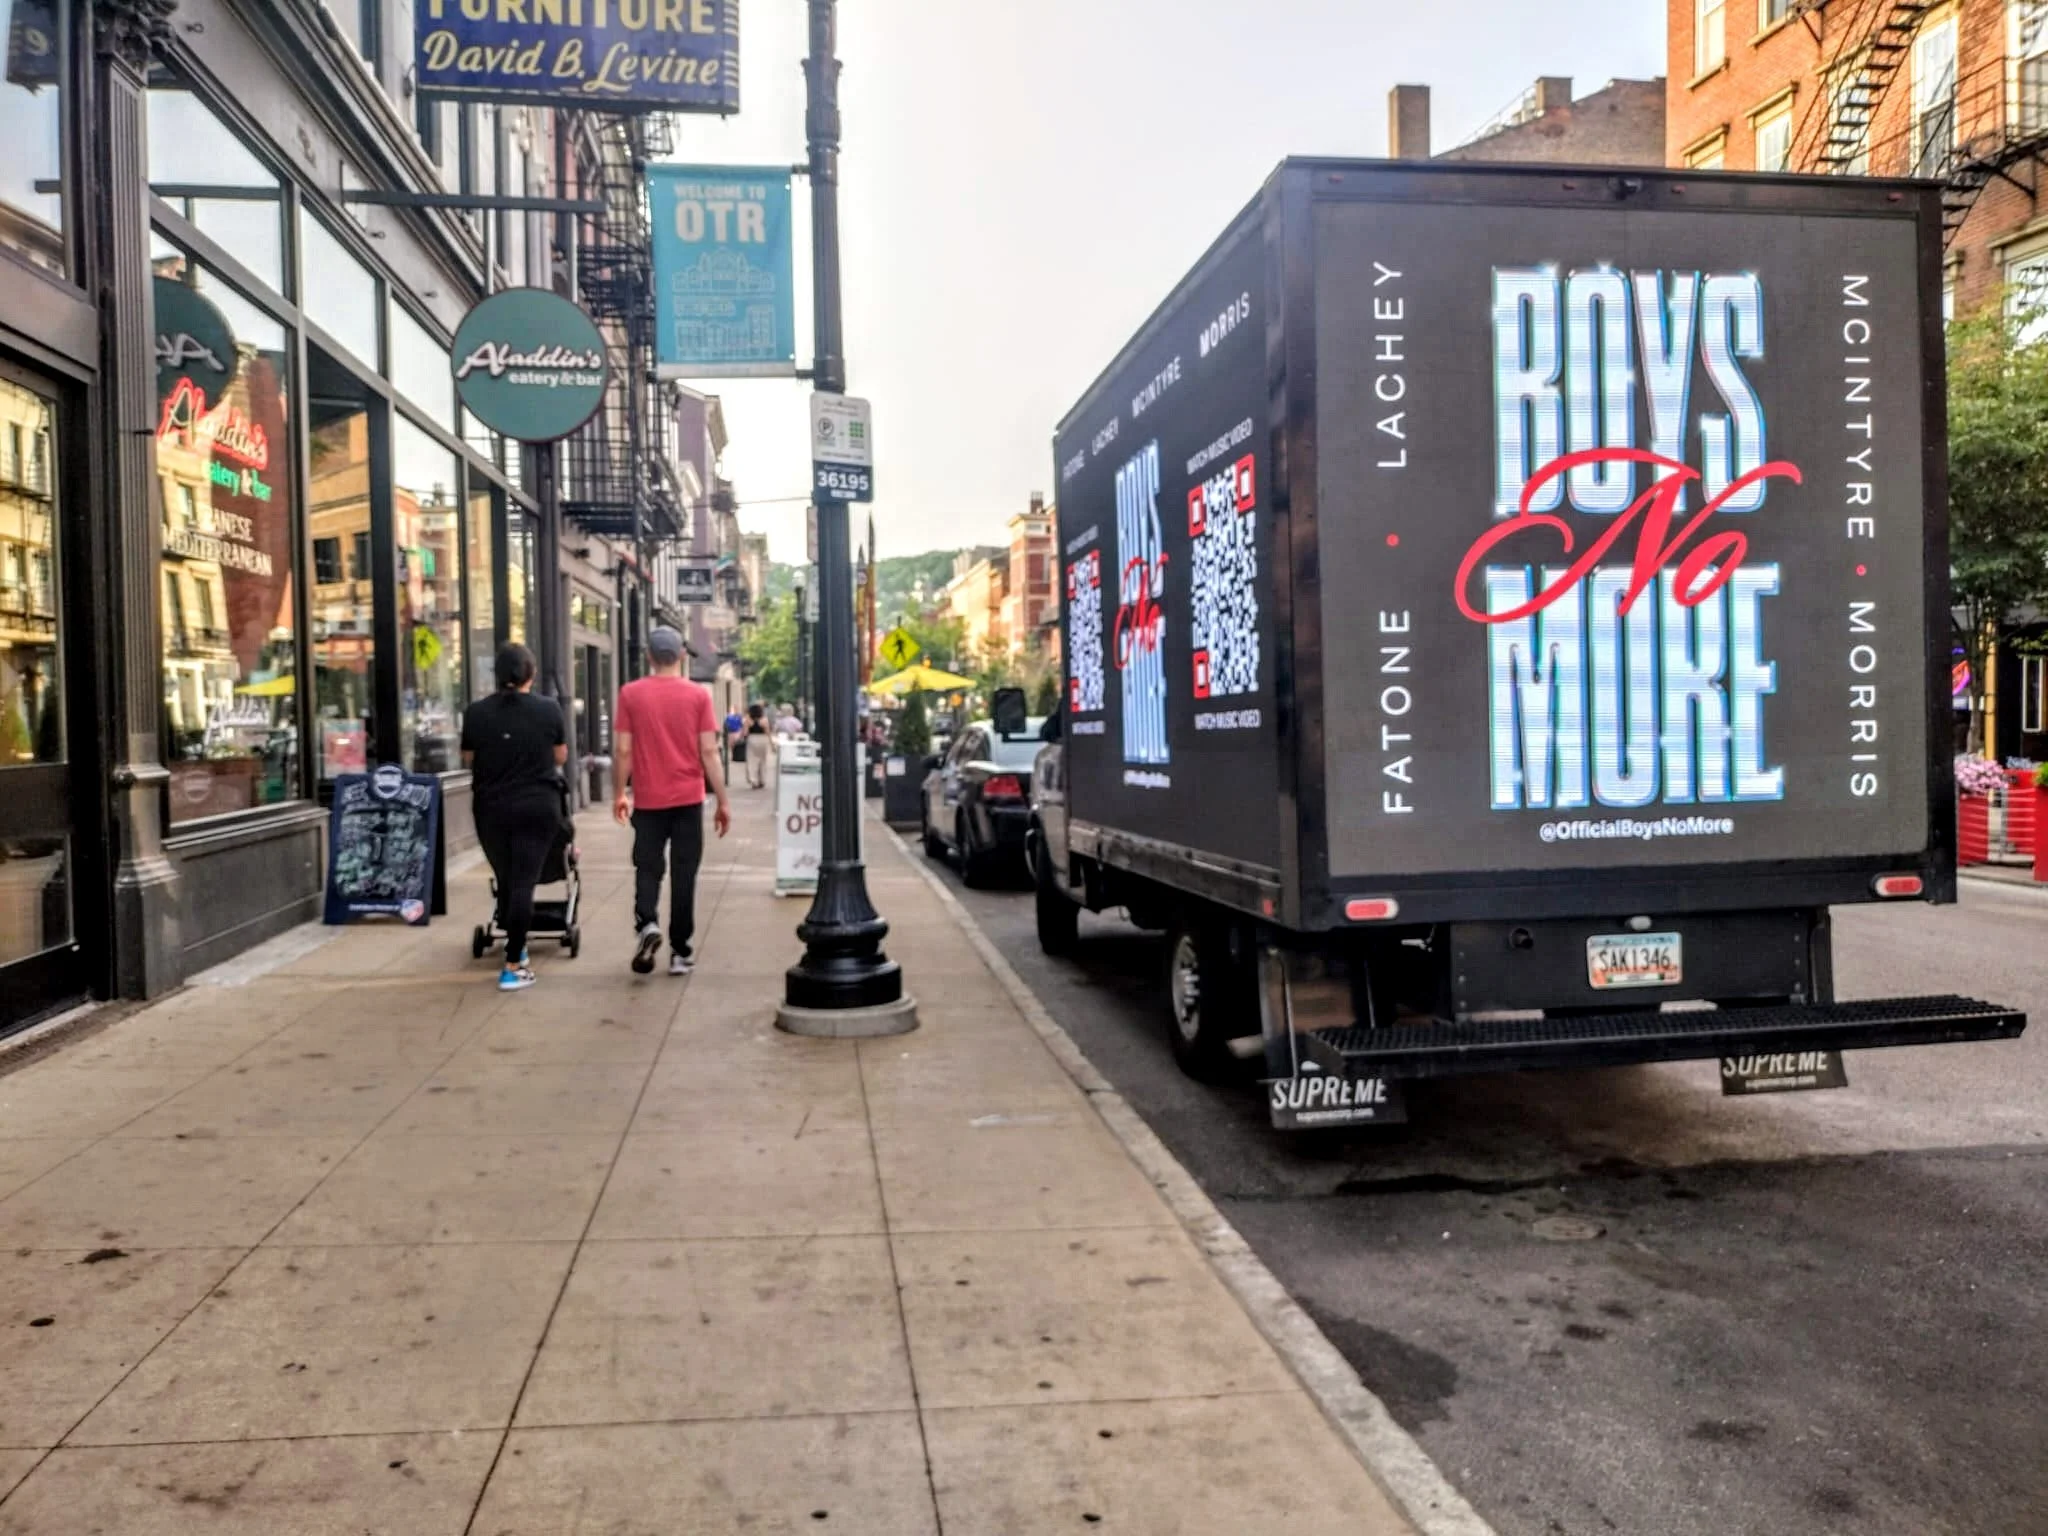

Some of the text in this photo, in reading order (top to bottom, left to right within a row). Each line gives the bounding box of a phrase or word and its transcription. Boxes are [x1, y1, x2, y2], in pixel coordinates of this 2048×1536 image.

[423, 30, 719, 92] David B. Levine
[674, 183, 766, 200] WELCOME TO
[675, 201, 766, 244] OTR
[1199, 291, 1250, 358] MORRIS
[455, 341, 602, 379] Aladdin's
[508, 371, 559, 389] eatery
[575, 371, 603, 386] bar
[1491, 262, 1767, 518] BOYS
[817, 471, 869, 491] 36195
[1373, 261, 1415, 814] FATONE LACHEY
[1454, 446, 1802, 623] No
[1842, 274, 1878, 796] MCINTYRE MORRIS
[1486, 561, 1785, 810] MORE
[1539, 816, 1735, 843] @OfficialBoysNoMore
[1598, 946, 1672, 973] SAK1346
[1721, 1050, 1829, 1078] SUPREME
[1271, 1076, 1388, 1111] SUPREME
